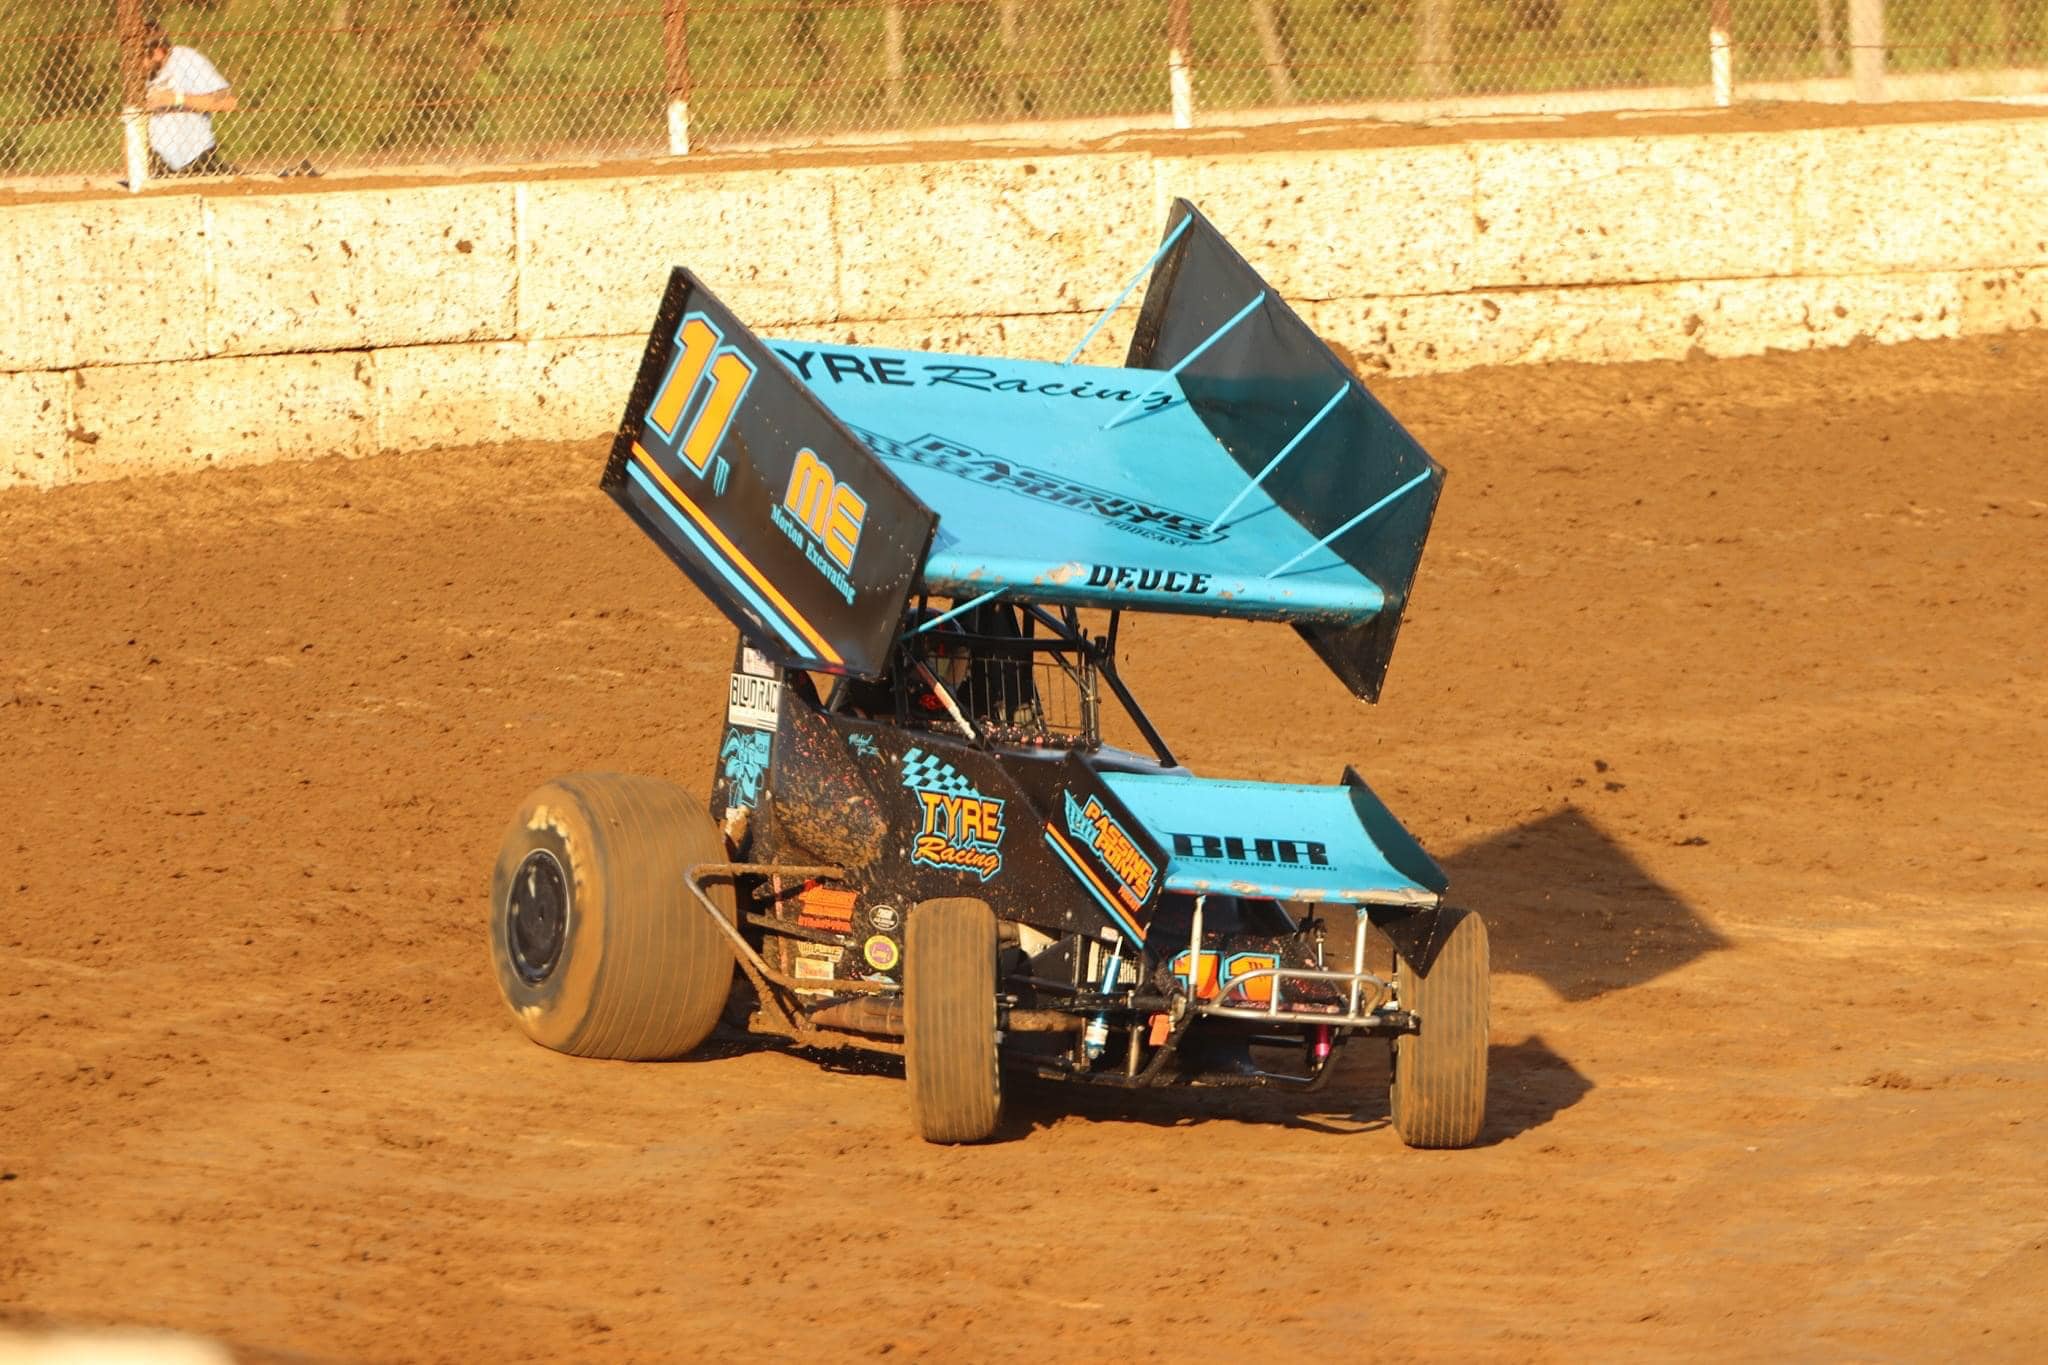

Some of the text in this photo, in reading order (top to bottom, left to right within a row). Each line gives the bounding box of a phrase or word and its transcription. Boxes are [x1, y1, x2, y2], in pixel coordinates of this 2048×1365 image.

[775, 347, 1173, 411] YRE Racing
[770, 504, 857, 606] Morton Excavating
[1086, 563, 1213, 595] DEUCE
[920, 791, 1001, 842] TYRE
[1084, 801, 1154, 882] PASSING
[914, 836, 999, 877] Racing
[1093, 830, 1150, 899] POINTS
